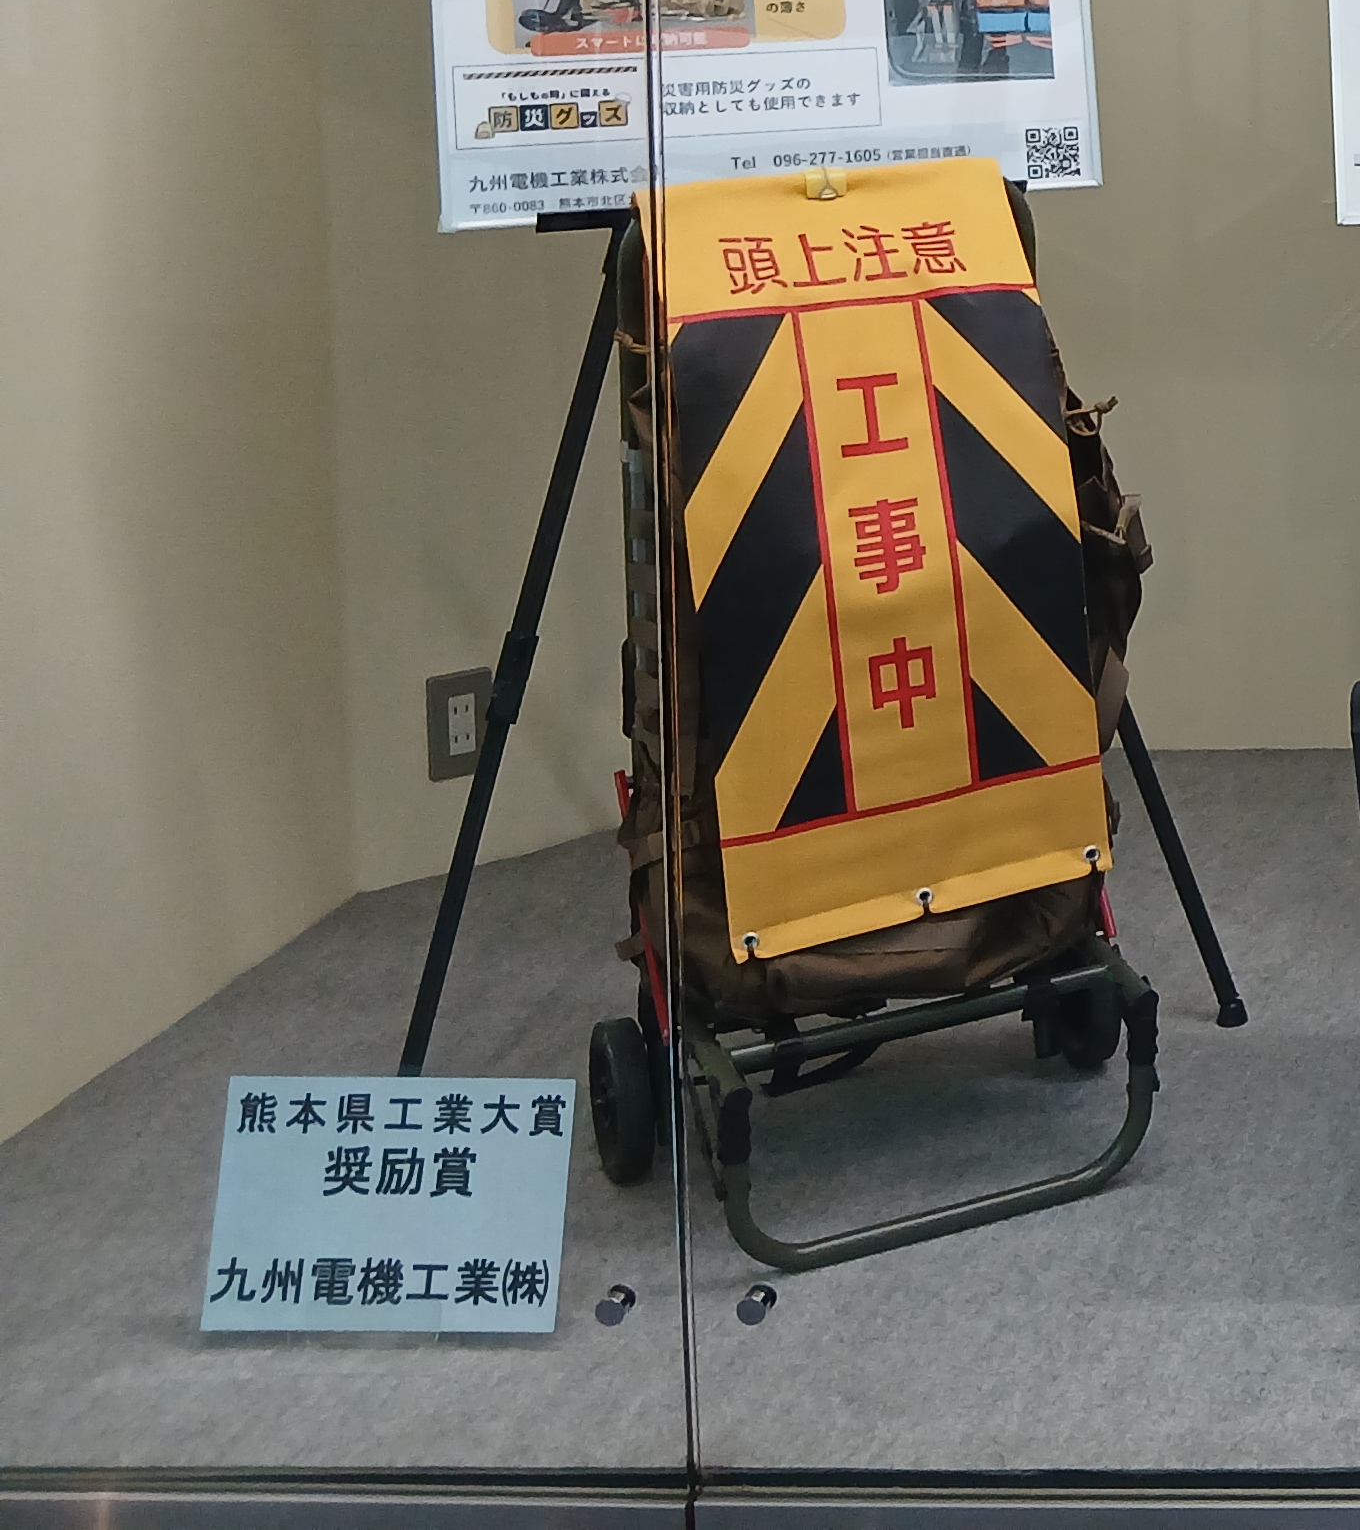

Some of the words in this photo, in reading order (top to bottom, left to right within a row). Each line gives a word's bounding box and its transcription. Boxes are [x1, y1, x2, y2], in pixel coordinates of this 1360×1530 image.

[494, 104, 622, 129] 防災グッズ
[468, 165, 660, 193] 九州電機工業株式会
[731, 156, 757, 169] Tel
[773, 147, 882, 168] 096-277-1605
[718, 220, 968, 295] 頭上注意
[836, 373, 938, 728] 工事中
[237, 1091, 567, 1137] 熊本県工業大賞
[322, 1146, 477, 1197] 奨励賞
